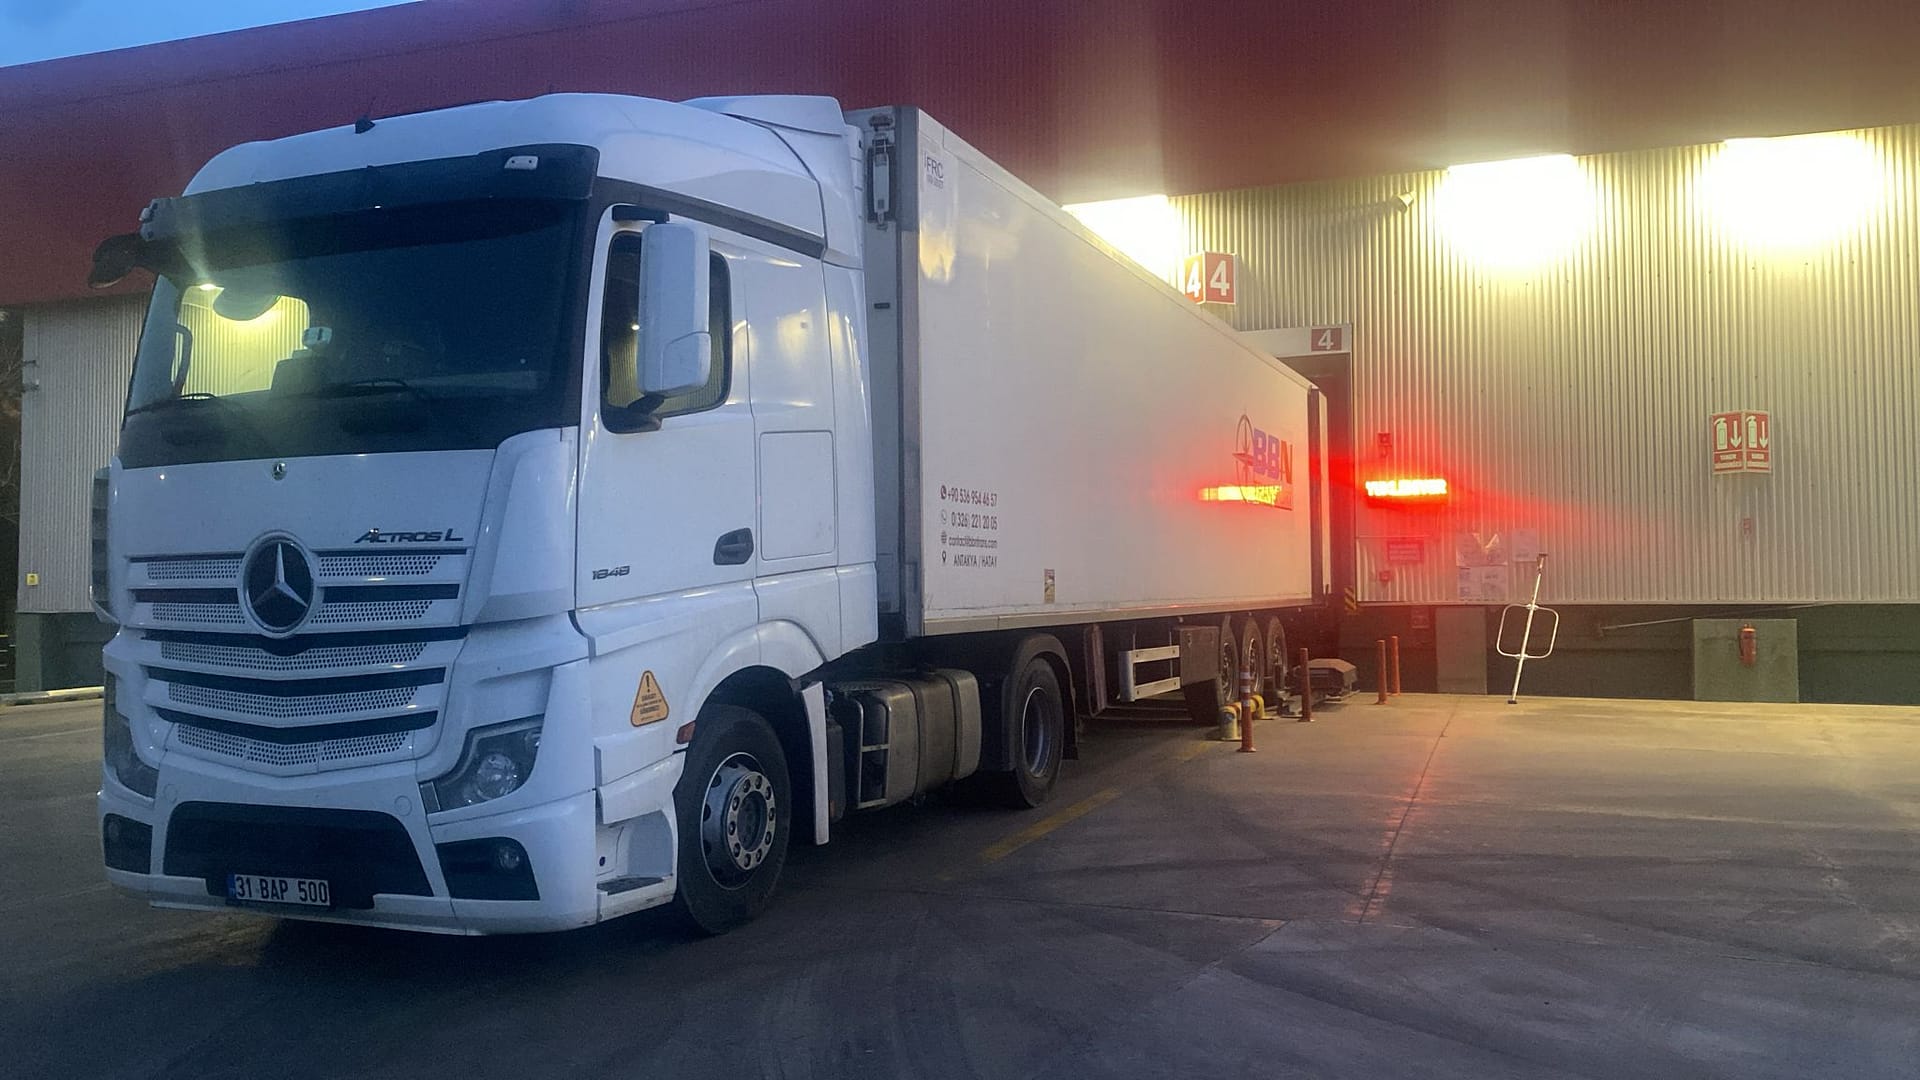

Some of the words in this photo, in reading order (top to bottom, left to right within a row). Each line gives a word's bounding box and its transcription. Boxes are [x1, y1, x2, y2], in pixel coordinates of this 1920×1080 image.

[927, 156, 943, 179] FRC
[1186, 260, 1201, 298] 4
[1210, 260, 1230, 296] 4
[1318, 329, 1334, 350] 4
[1253, 428, 1292, 484] BBN
[947, 487, 958, 502] +90
[960, 488, 970, 504] 536
[971, 490, 981, 505] 954
[982, 491, 990, 506] 46
[991, 493, 998, 507] 57
[971, 513, 981, 529] 221
[982, 515, 990, 529] 20
[990, 515, 998, 530] 05
[953, 554, 977, 567] ANTAKYA
[982, 554, 998, 568] HATAY
[592, 565, 630, 580] 1848
[235, 876, 252, 898] 31
[260, 879, 288, 900] BAP
[298, 881, 328, 903] 500
